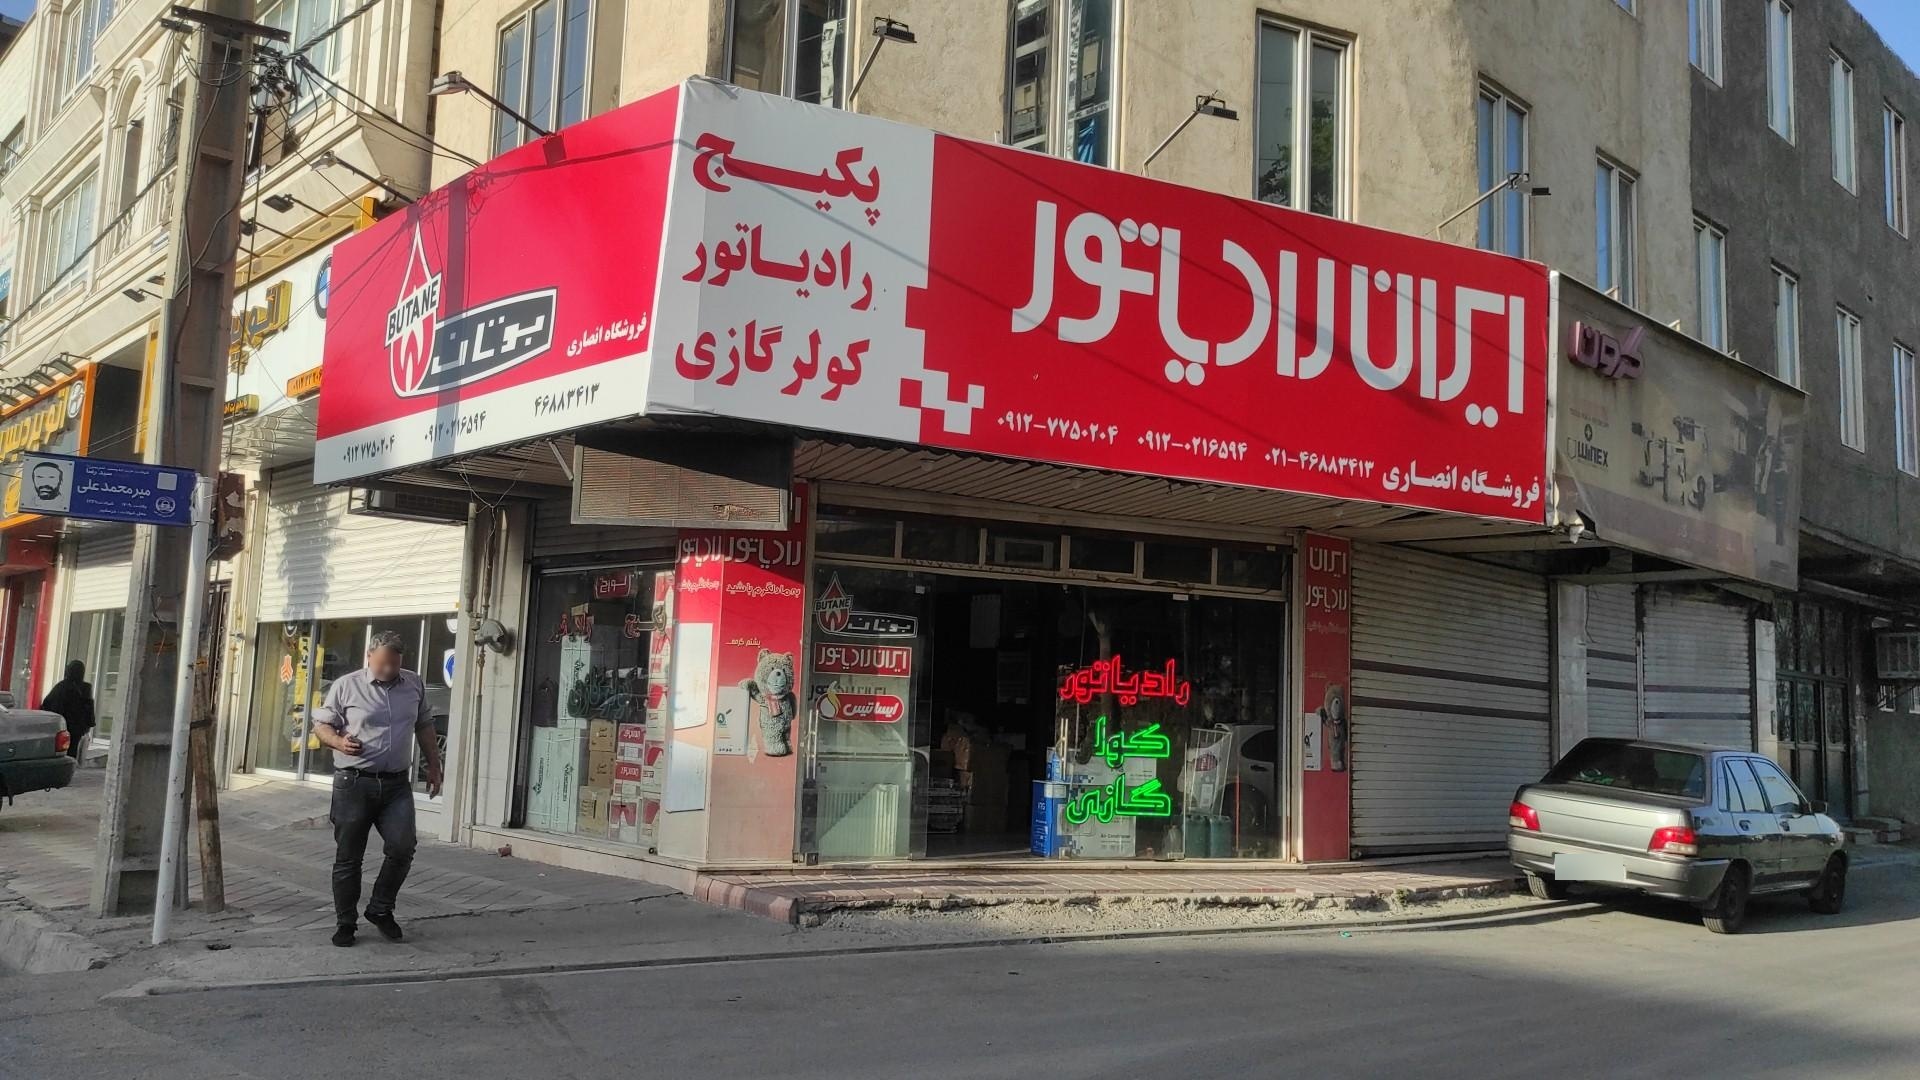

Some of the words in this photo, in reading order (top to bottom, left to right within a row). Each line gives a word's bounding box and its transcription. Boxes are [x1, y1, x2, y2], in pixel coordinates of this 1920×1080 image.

[692, 132, 881, 226] پکیج
[682, 223, 873, 311] رادیاتور
[387, 279, 439, 341] BUTANE
[1011, 200, 1335, 386] رادیاتور
[566, 324, 603, 358] انصاری
[604, 311, 648, 342] فروشگاه
[431, 315, 546, 375] بوتان
[675, 320, 783, 386] گازی
[1350, 263, 1524, 428] ایران
[780, 328, 870, 401] کولر
[534, 382, 601, 417] ۴۶۸۸۳۴۱۳
[1382, 460, 1459, 493] انصاری
[1460, 469, 1541, 509] فروشگاه
[675, 535, 722, 567] رادیاتور
[724, 537, 802, 569] رادیاتور
[1309, 547, 1347, 578] ایران
[815, 599, 851, 611] BUTANE
[1305, 585, 1348, 613] رادیاتور
[848, 617, 911, 633] بوتان
[818, 647, 871, 670] رادیاتور
[873, 649, 908, 673] ایران
[1059, 654, 1191, 706] رادیاتور
[1066, 772, 1172, 825] گازی
